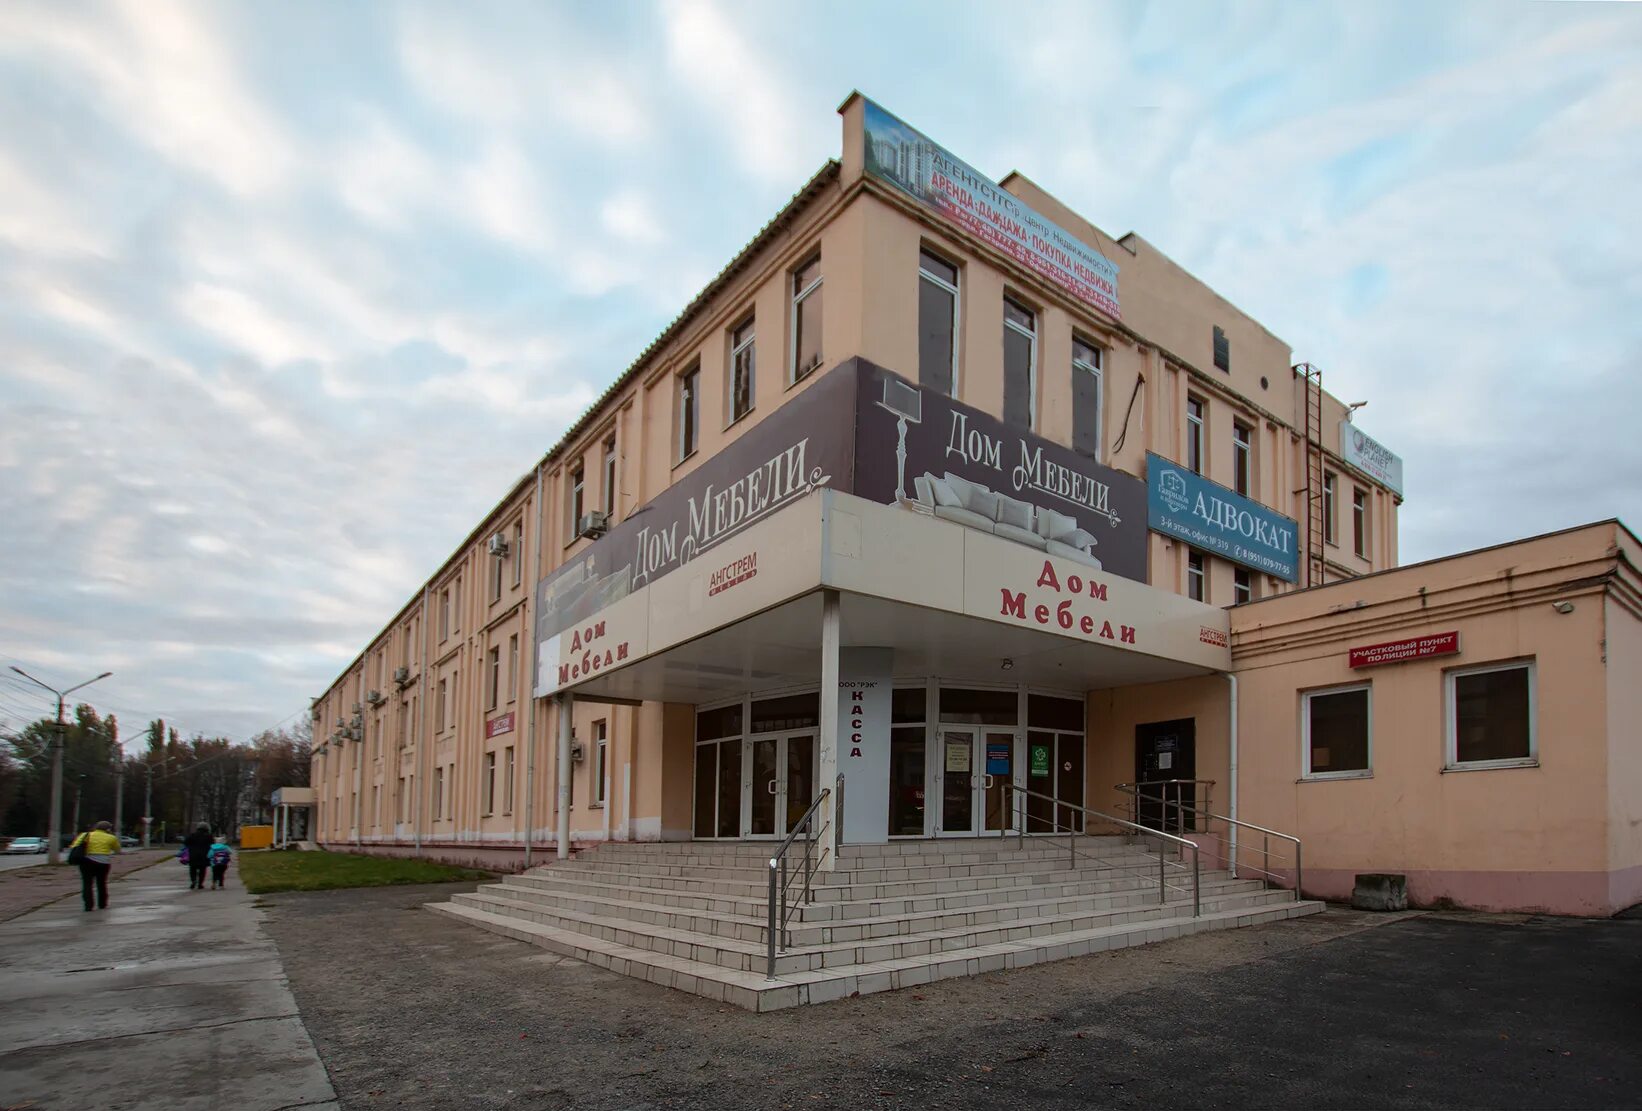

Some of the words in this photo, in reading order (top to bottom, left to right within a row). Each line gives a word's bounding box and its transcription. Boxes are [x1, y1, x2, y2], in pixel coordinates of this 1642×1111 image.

[931, 170, 975, 210] АРЕНДА
[1032, 235, 1073, 271] ПОКУПКА
[1192, 491, 1292, 553] АДВОКАТ
[710, 551, 757, 589] АНГСТРЕМ
[1037, 560, 1108, 602] Дом
[1000, 588, 1136, 644] Мебели
[570, 621, 606, 655] Дом
[1353, 641, 1417, 658] УЧАСТКОВЫЙ
[1419, 635, 1453, 647] ПУНКТ
[1367, 650, 1417, 662] ПОЛИЦИИ
[1419, 645, 1437, 654] №7
[558, 642, 629, 686] Мебели
[850, 691, 864, 757] КАССА
